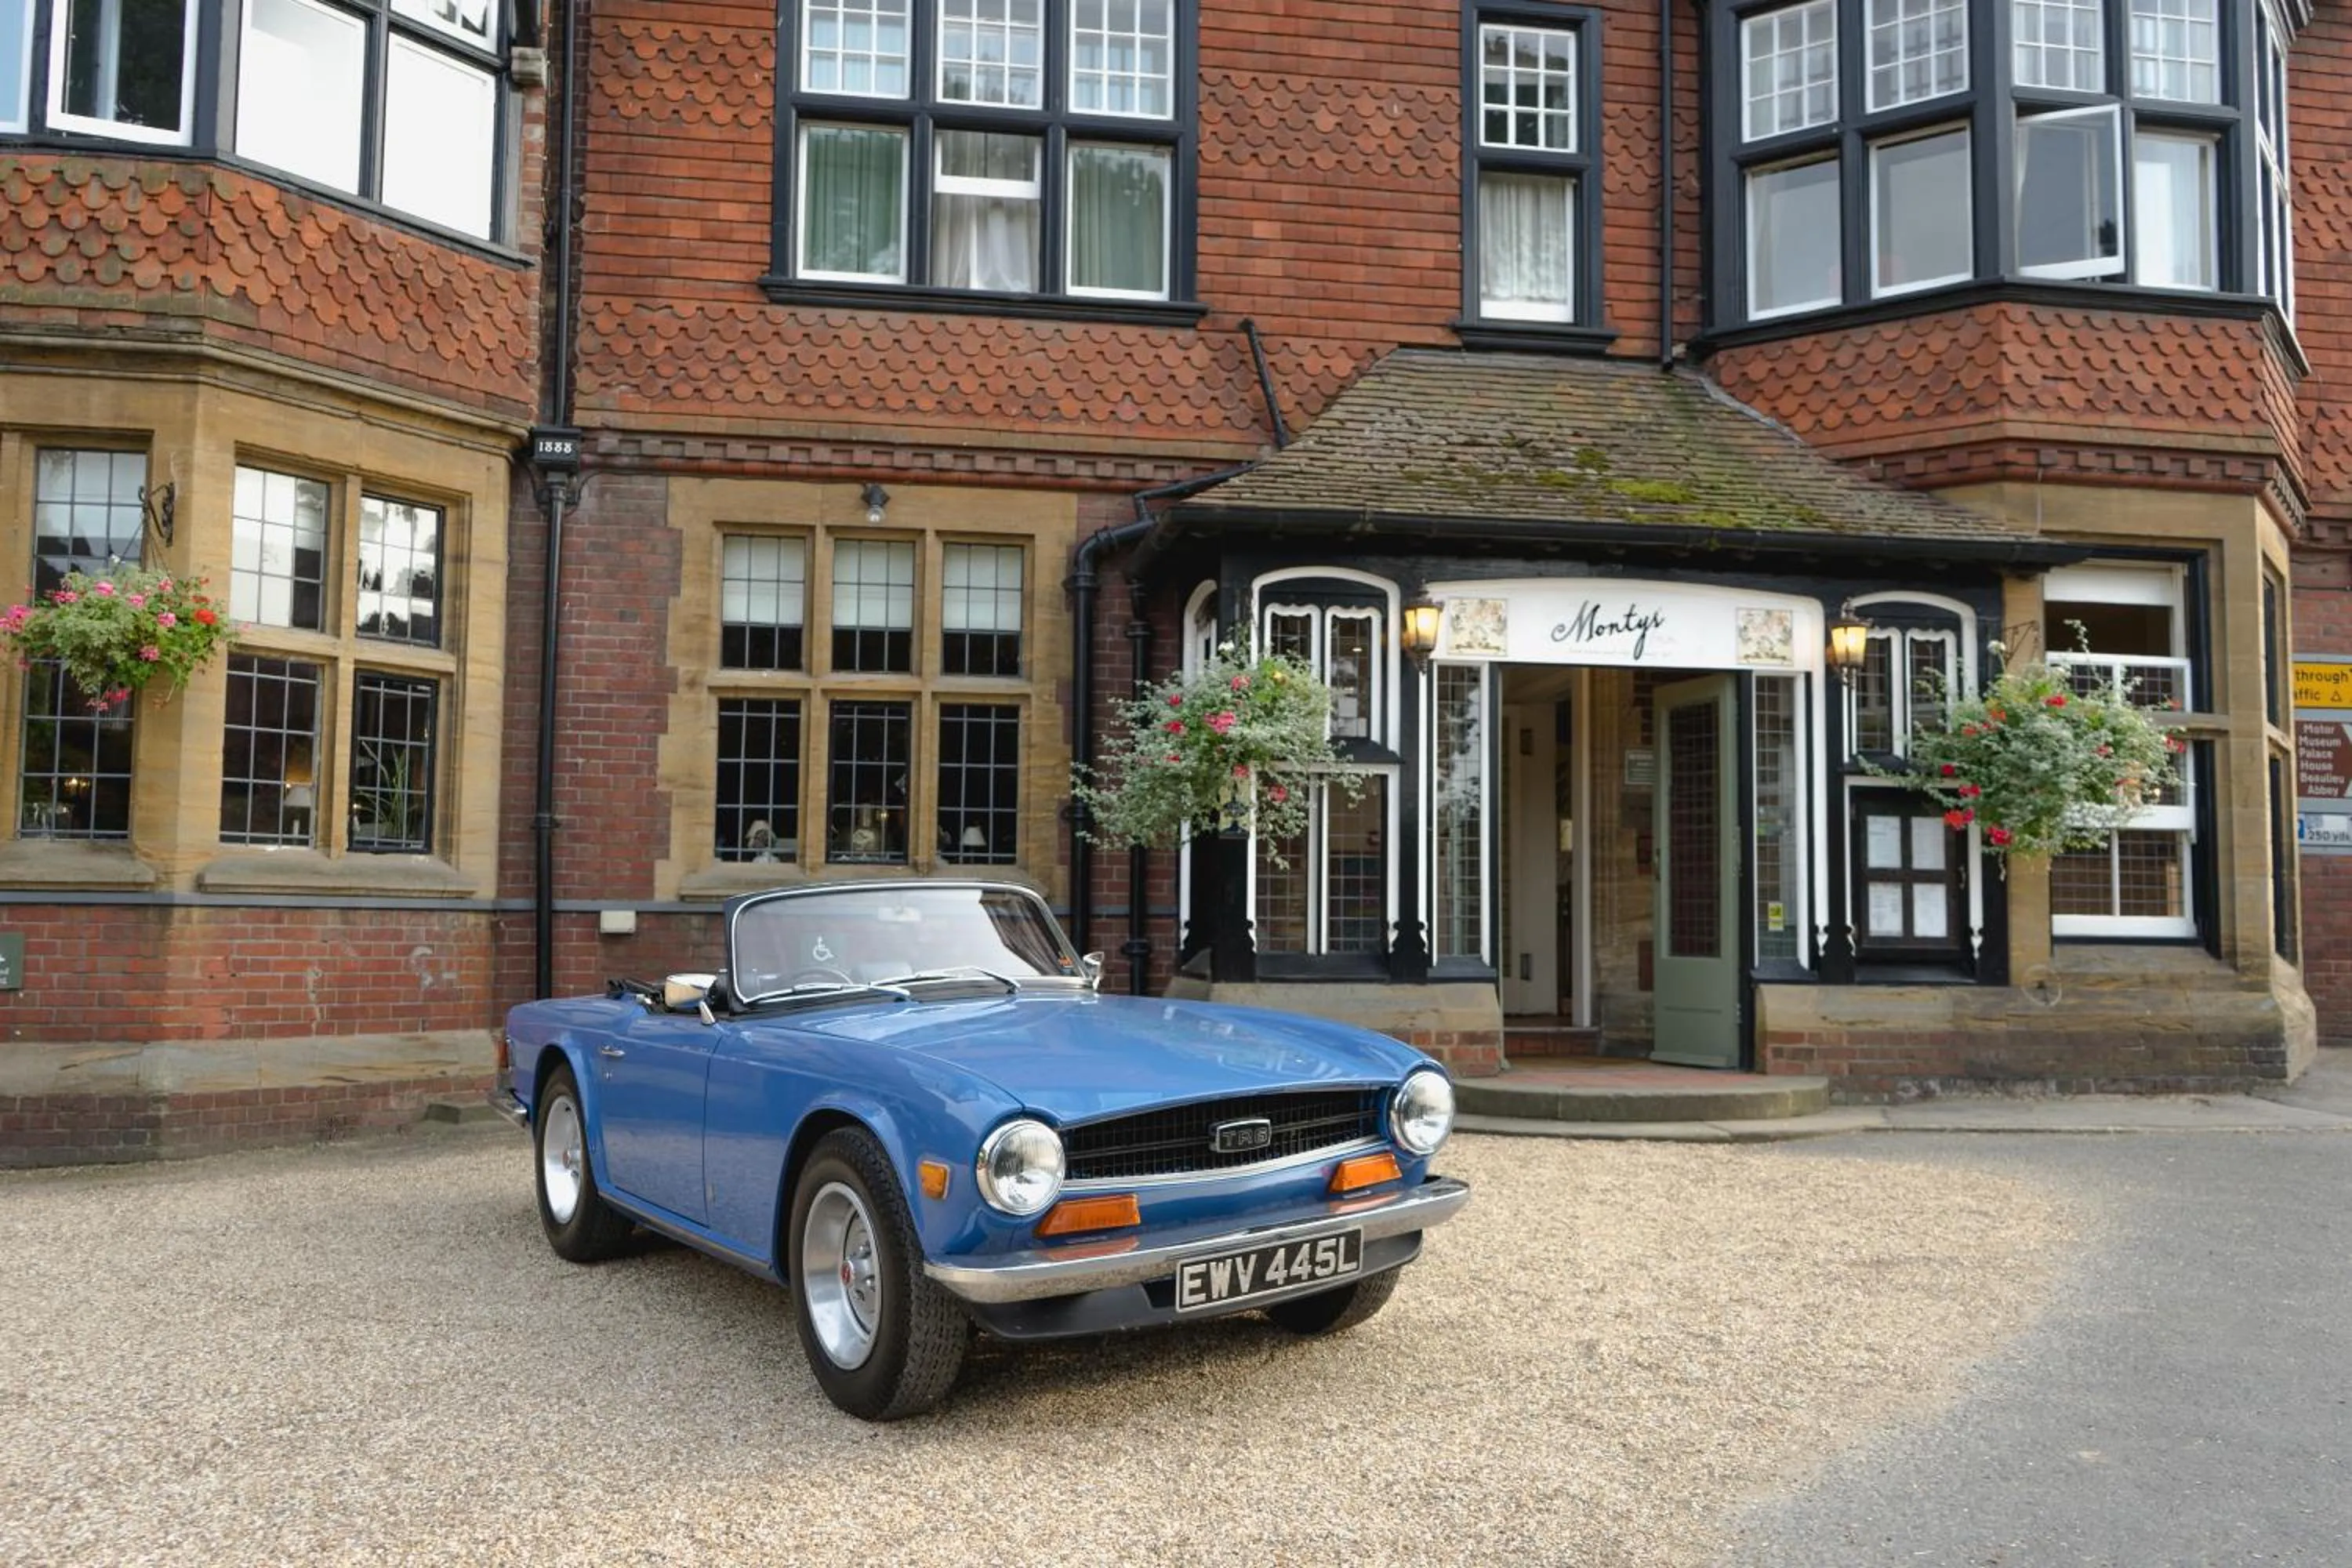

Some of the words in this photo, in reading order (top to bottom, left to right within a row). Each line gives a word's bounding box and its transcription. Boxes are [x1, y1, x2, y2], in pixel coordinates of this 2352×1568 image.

[539, 441, 572, 453] 1888
[2296, 670, 2349, 684] through
[2303, 724, 2335, 734] Motor
[2299, 735, 2342, 747] Museum
[2299, 747, 2333, 759] Palace
[2300, 760, 2333, 771] House
[2300, 773, 2345, 783] Beaulieu
[2307, 785, 2338, 796] Abbey
[2307, 829, 2330, 841] 250
[1222, 1127, 1268, 1147] TR6
[1182, 1254, 1257, 1305] EWV
[1265, 1236, 1357, 1285] 445L
